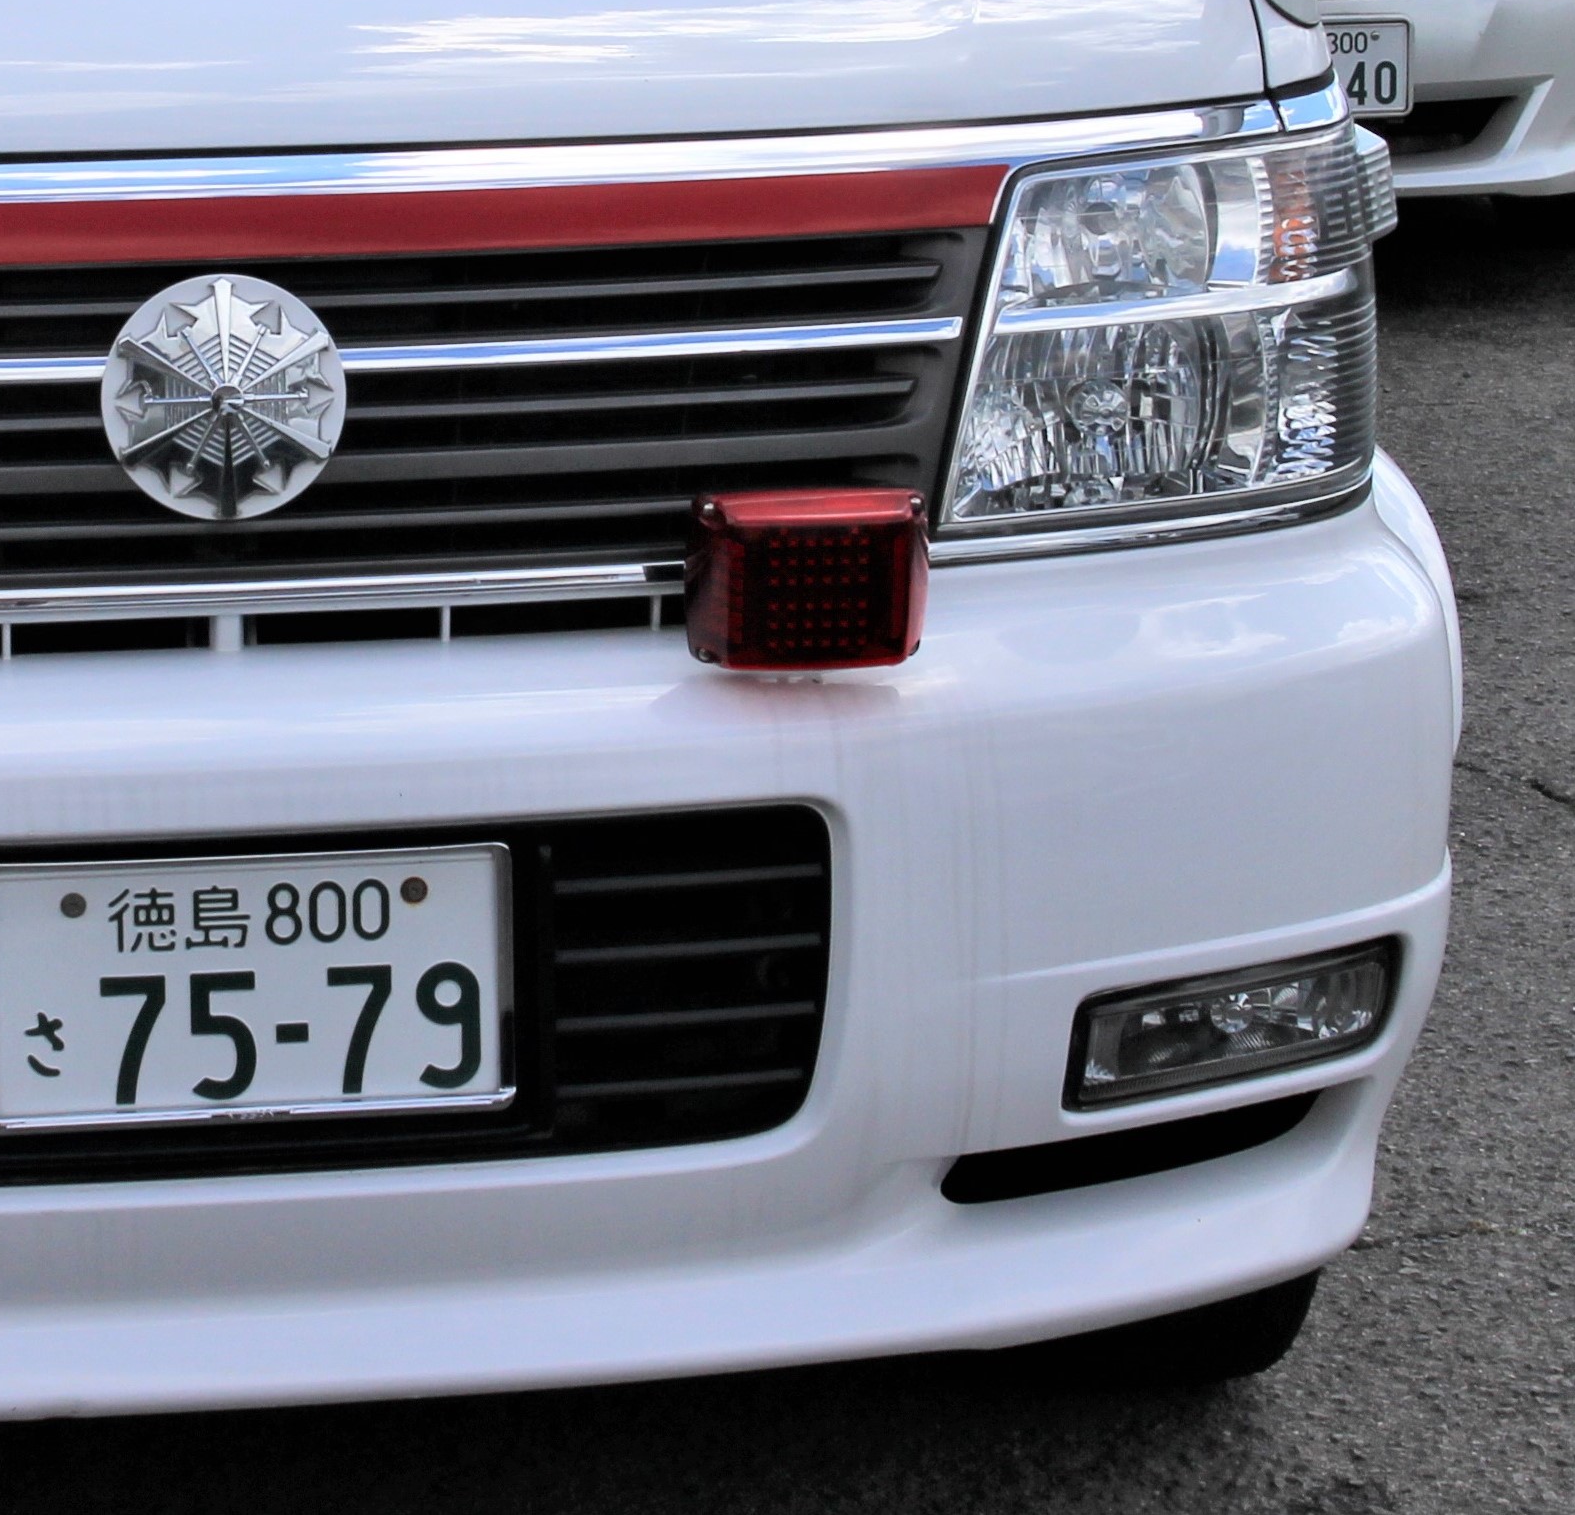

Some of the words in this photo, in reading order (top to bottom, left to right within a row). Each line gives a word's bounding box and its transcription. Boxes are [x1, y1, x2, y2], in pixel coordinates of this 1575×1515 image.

[107, 885, 251, 953] 徳島
[264, 878, 391, 946] 800
[24, 1011, 65, 1078] さ
[99, 960, 482, 1106] 75-79
